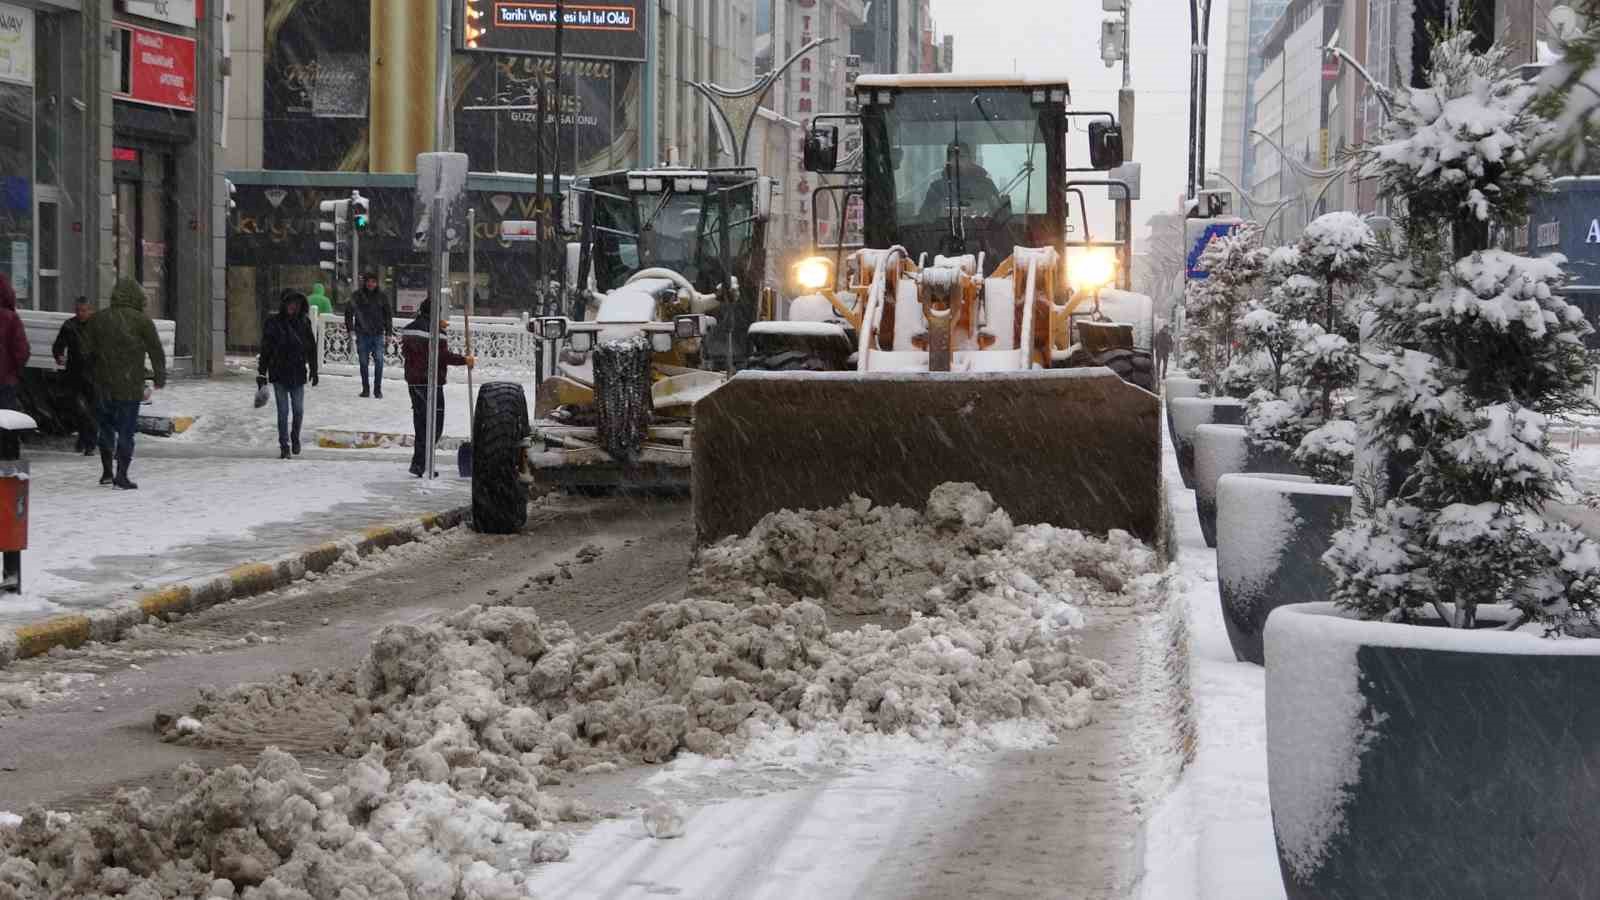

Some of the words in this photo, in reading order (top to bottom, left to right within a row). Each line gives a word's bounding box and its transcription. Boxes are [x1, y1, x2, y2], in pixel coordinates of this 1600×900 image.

[501, 8, 527, 21] Tarihi
[529, 9, 547, 22] Van
[549, 10, 576, 23] Kesi
[578, 10, 591, 25] Işıl
[592, 11, 605, 25] Işıl
[606, 12, 630, 25] Oldu
